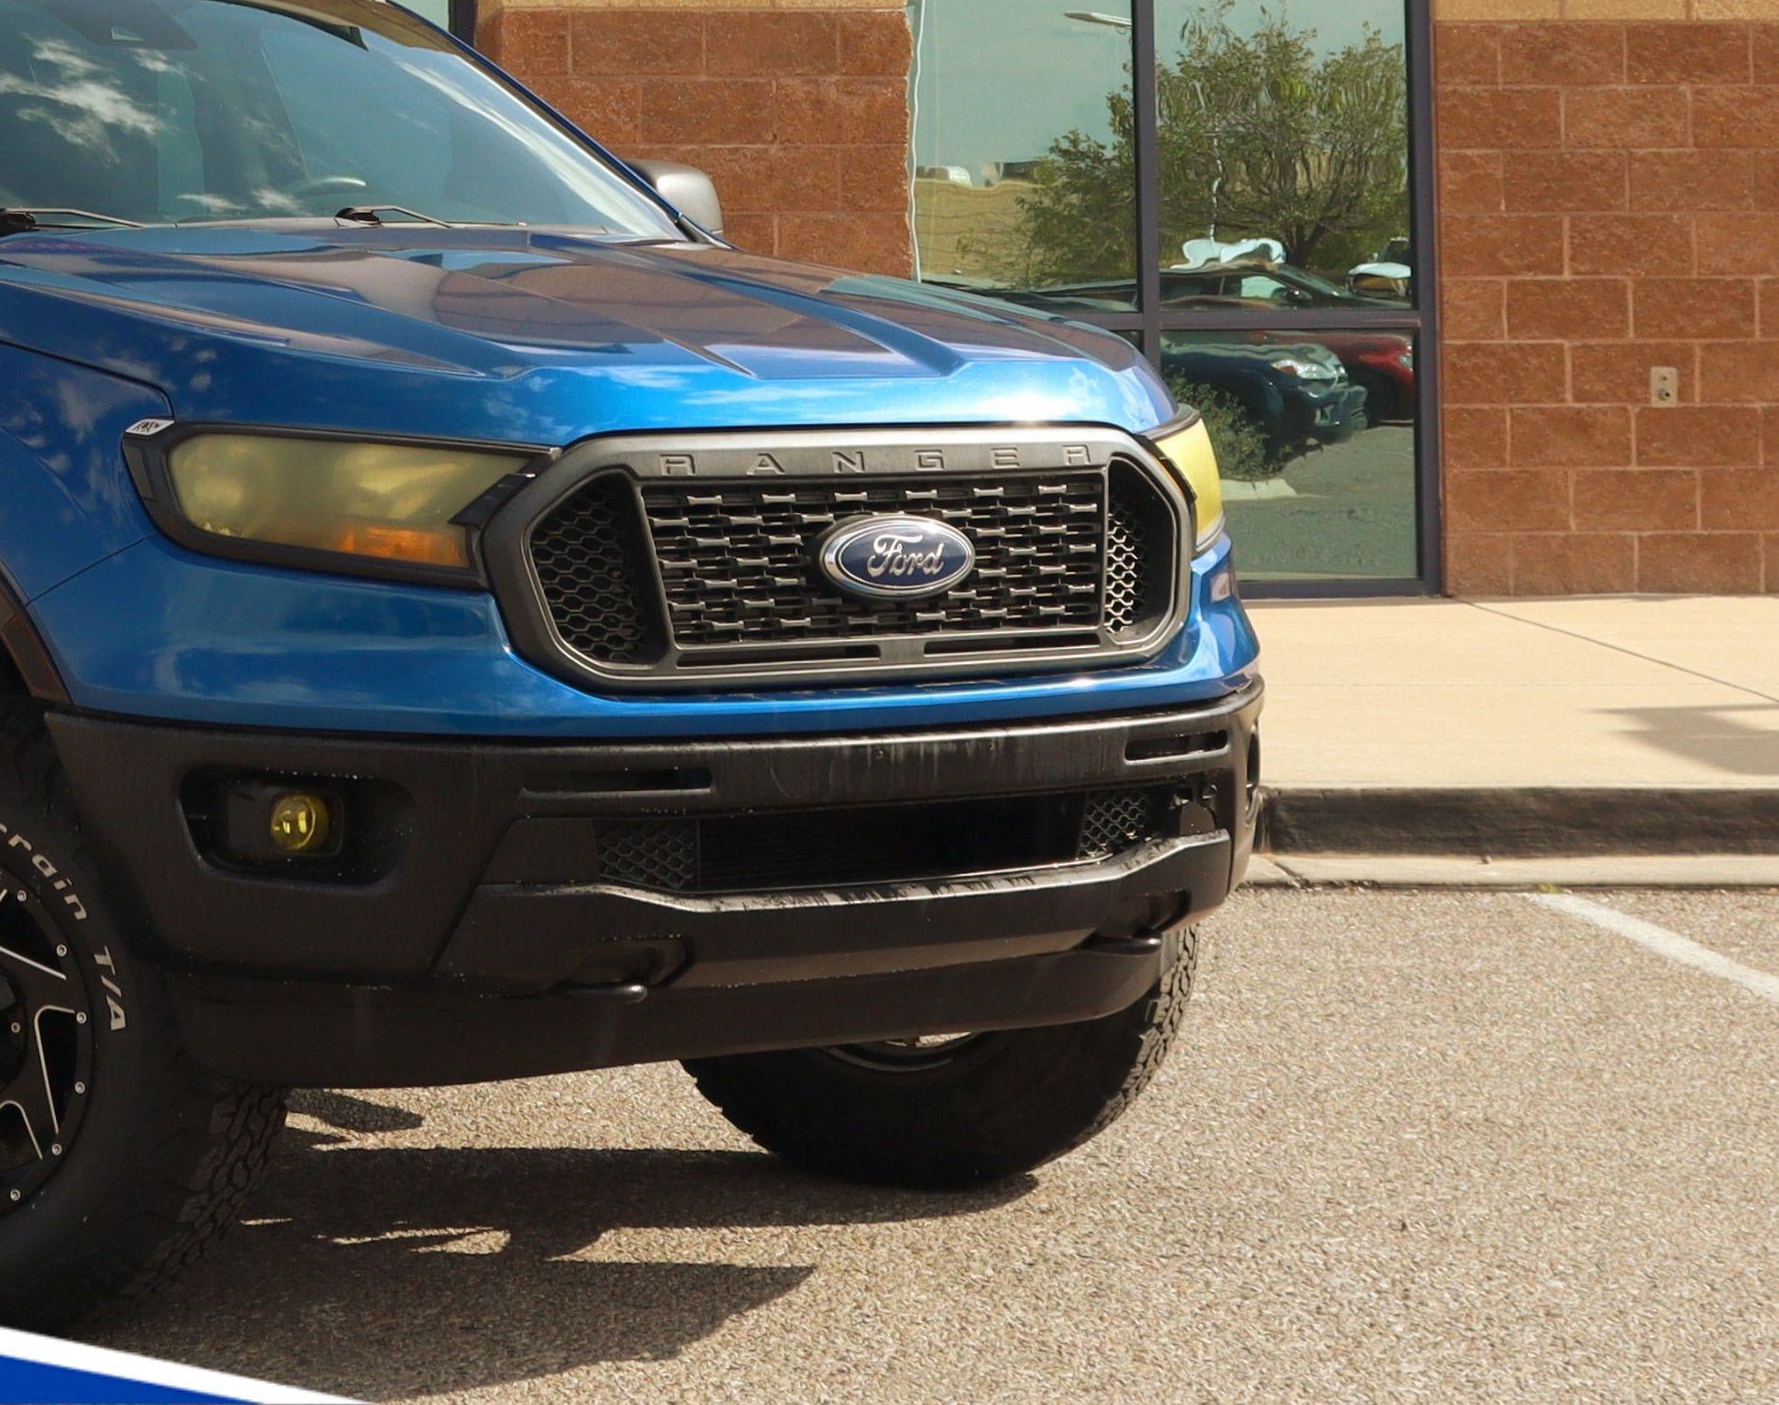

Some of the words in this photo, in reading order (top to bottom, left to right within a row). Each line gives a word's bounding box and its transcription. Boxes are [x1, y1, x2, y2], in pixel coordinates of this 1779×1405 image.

[661, 444, 1092, 476] RANGER
[867, 534, 945, 578] Ford
[92, 945, 130, 1033] T/A
